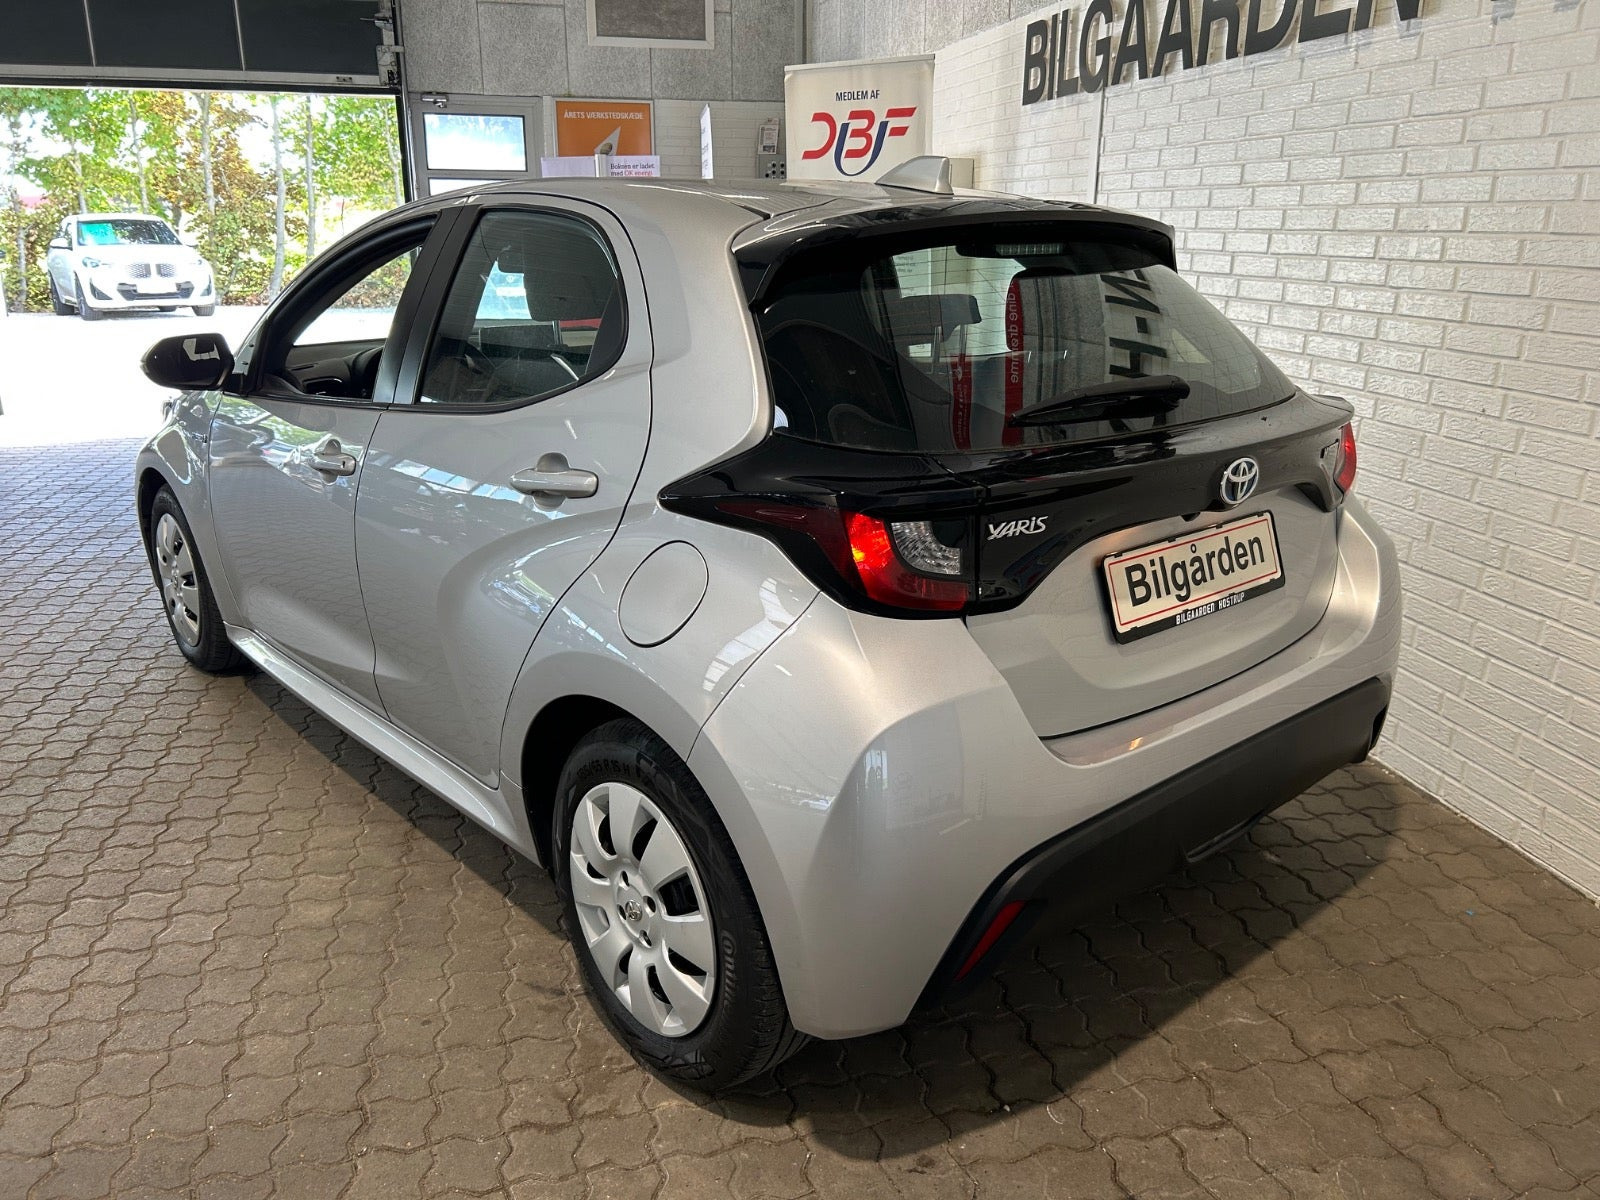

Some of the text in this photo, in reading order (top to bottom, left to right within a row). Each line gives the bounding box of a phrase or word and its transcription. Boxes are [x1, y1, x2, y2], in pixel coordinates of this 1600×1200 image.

[1022, 0, 1418, 106] BILGAAR
[835, 89, 880, 101] MEDLEM AF
[563, 109, 645, 120] ÅRETS VÆRKSTEDSKÆDE
[1124, 535, 1265, 607] Bilgården
[1175, 592, 1245, 625] BILGAARDEN HOSTRUP
